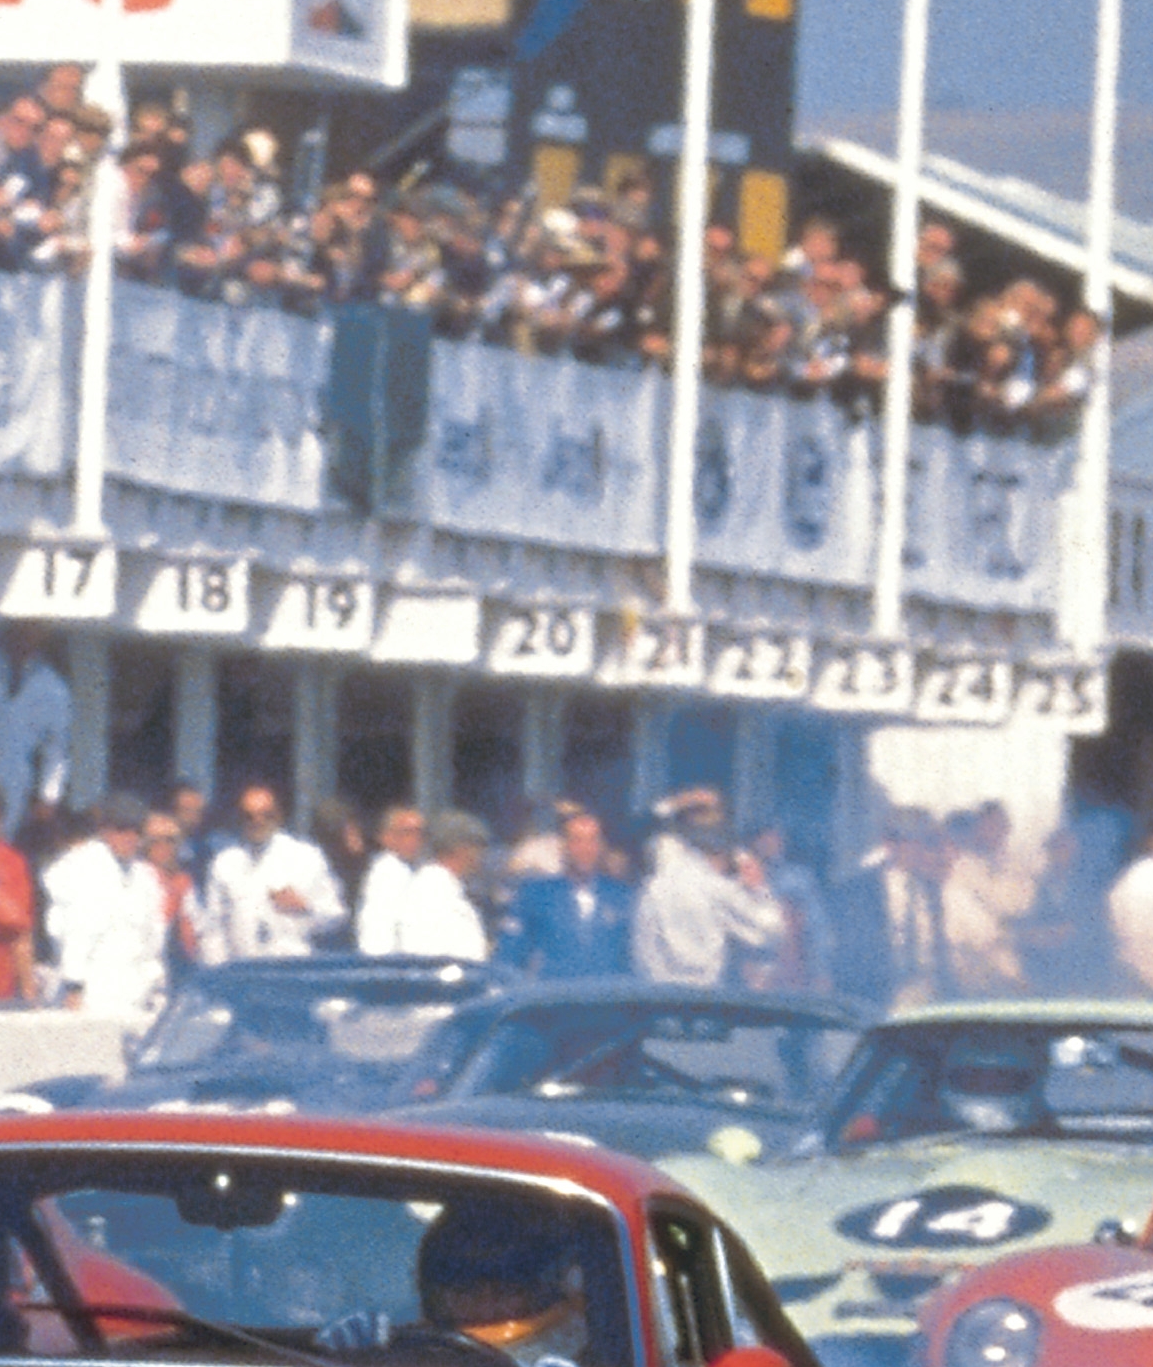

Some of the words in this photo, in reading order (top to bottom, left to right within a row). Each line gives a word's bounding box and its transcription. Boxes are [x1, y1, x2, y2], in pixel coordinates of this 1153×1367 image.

[44, 551, 90, 598] 17
[179, 565, 229, 613] 18
[305, 582, 356, 630] 19
[511, 615, 575, 657] 20
[876, 1200, 1014, 1238] 14
